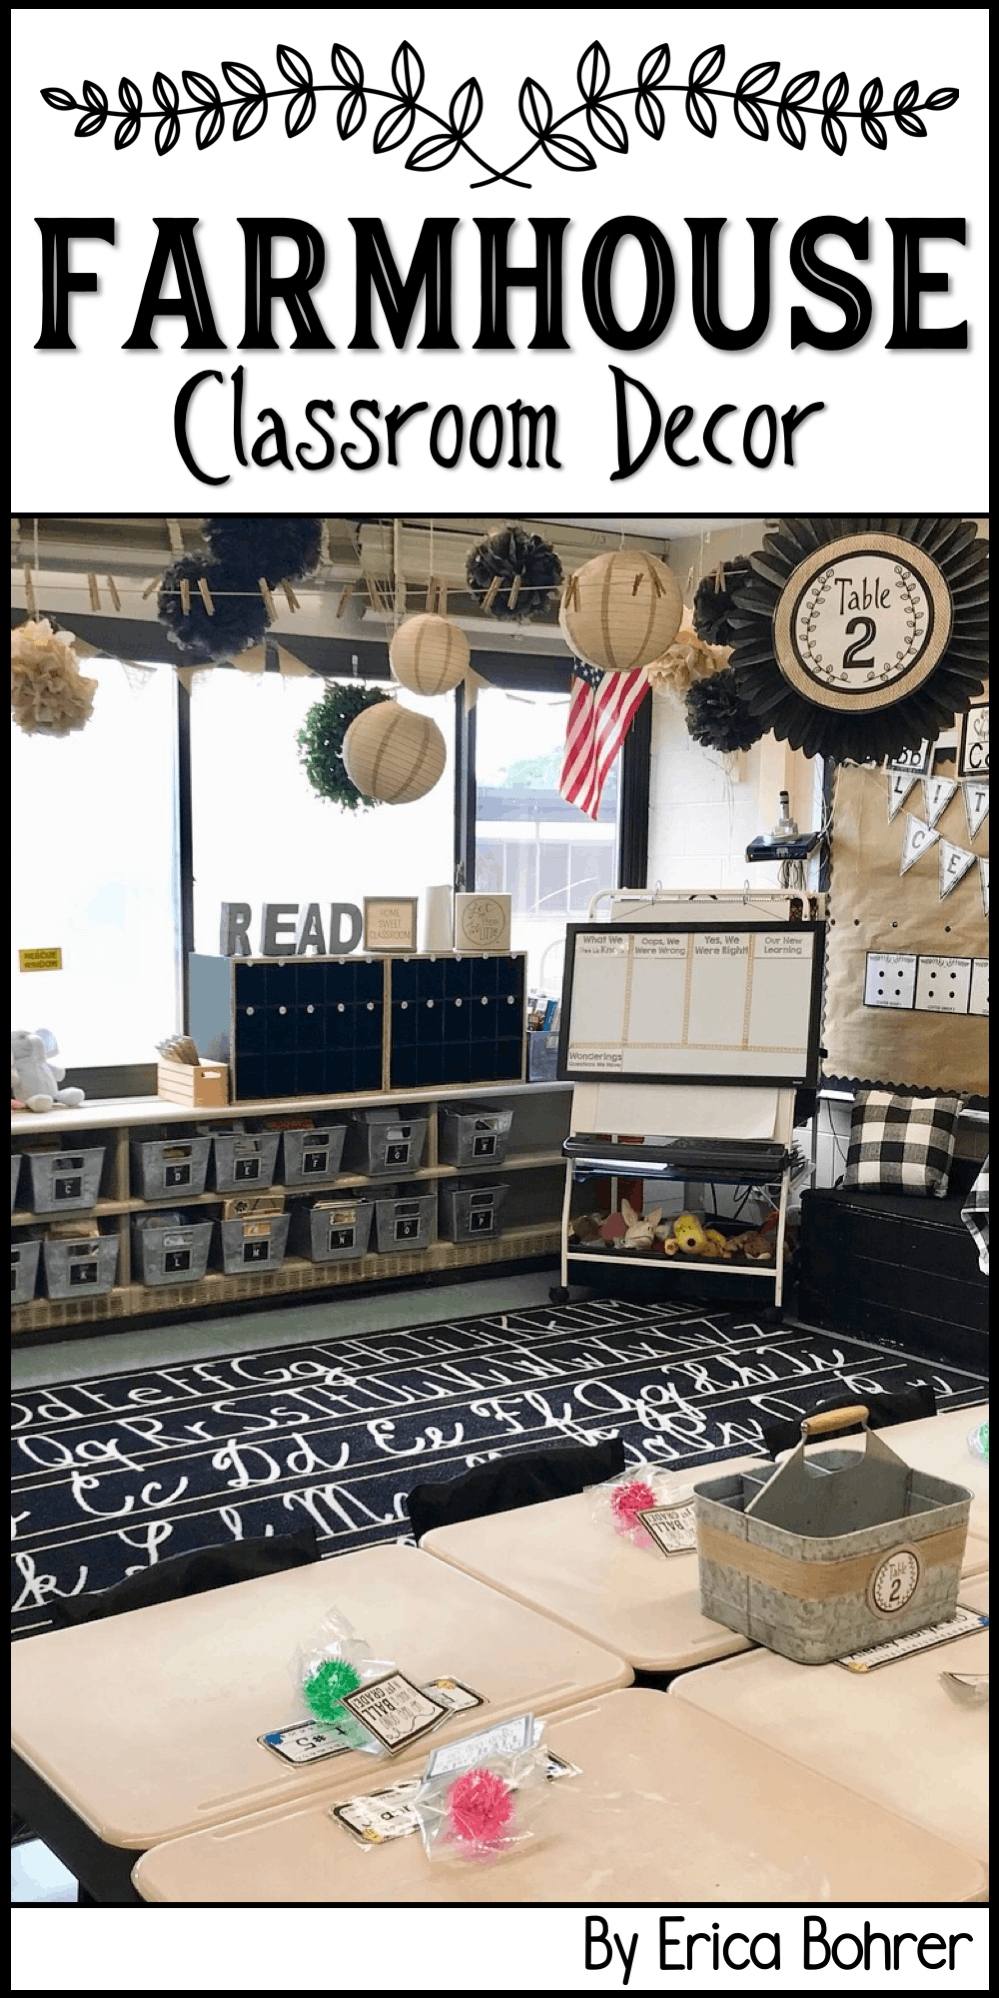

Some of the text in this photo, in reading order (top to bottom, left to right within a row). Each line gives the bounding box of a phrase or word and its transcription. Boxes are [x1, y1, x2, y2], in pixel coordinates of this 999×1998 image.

[834, 577, 891, 615] Table
[843, 616, 876, 668] 2
[220, 902, 362, 956] READ
[725, 935, 740, 945] We
[659, 947, 686, 956] Wrong
[695, 946, 720, 955] Were
[764, 946, 803, 955] Learning
[569, 1052, 623, 1062] Wonderings
[651, 1519, 684, 1533] BALL
[889, 1562, 908, 1581] Table
[890, 1578, 902, 1602] 2
[361, 1701, 396, 1721] BALL
